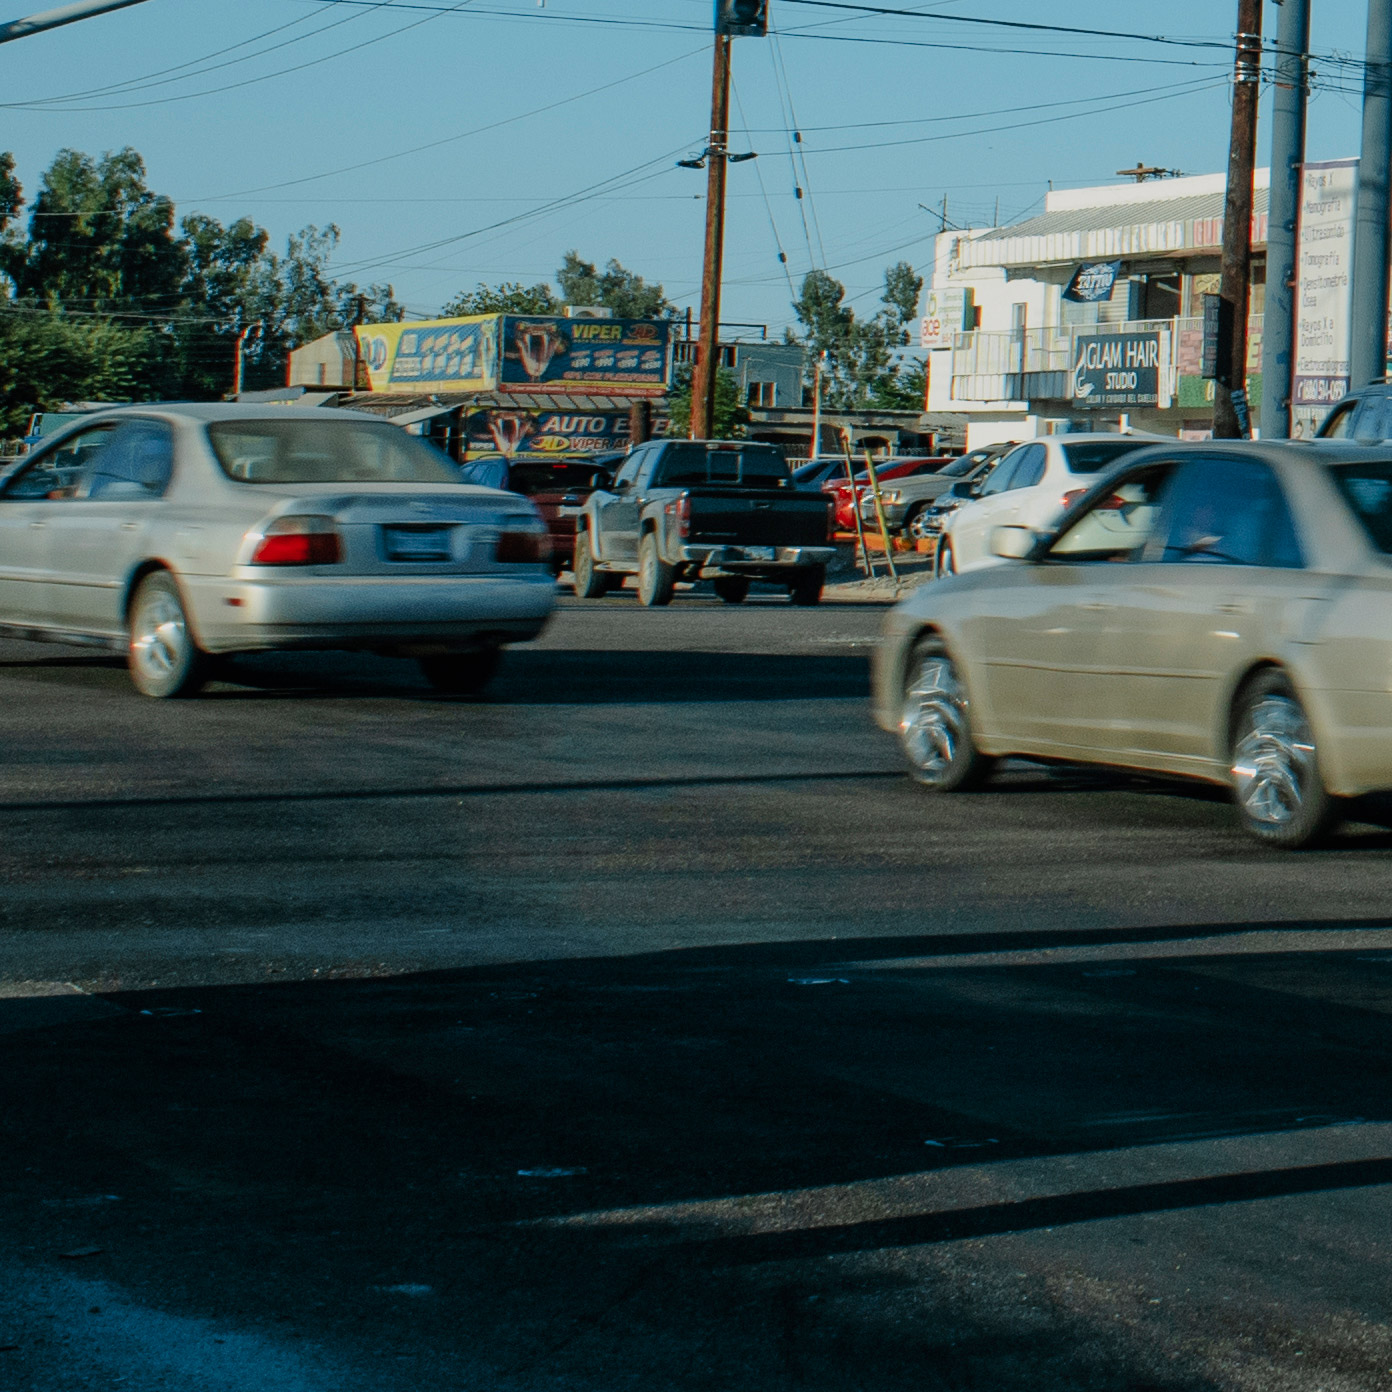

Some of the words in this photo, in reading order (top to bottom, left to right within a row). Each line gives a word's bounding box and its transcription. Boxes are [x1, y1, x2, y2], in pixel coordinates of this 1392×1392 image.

[571, 324, 622, 340] VIPER
[1086, 340, 1122, 370] GLAM
[1126, 339, 1159, 368] HAIR
[1105, 371, 1138, 390] STUDIO
[541, 416, 607, 433] AUTO
[570, 437, 609, 451] VIPER
